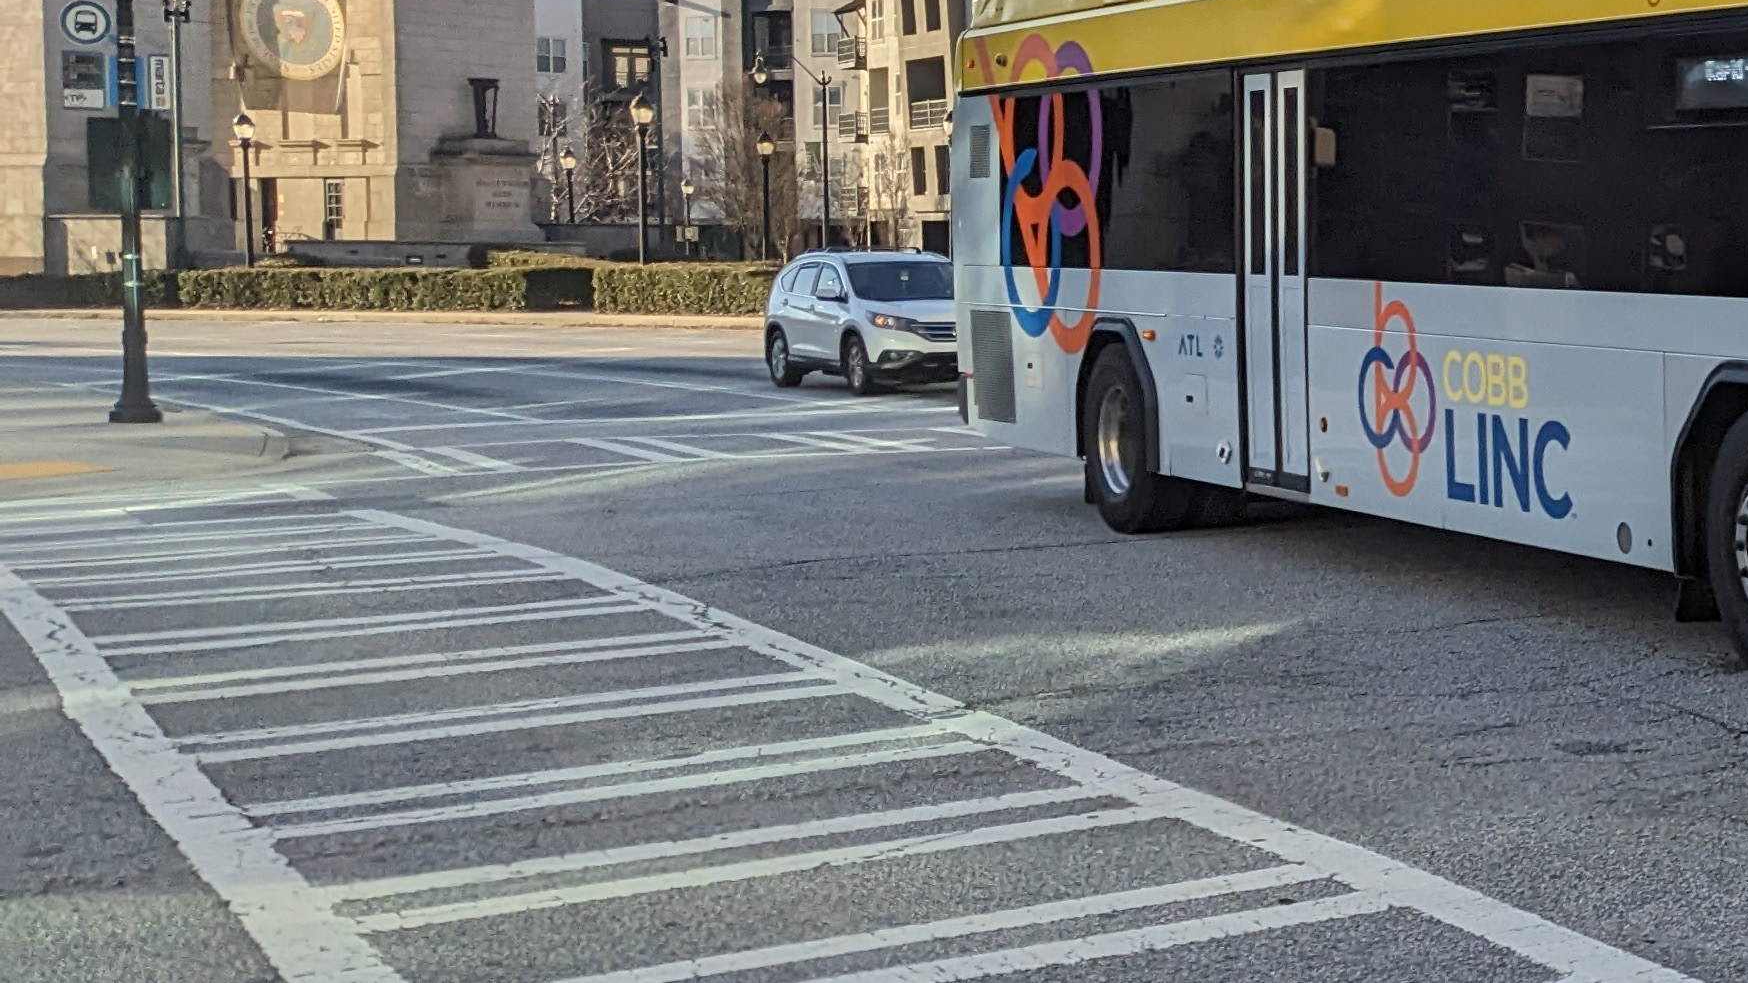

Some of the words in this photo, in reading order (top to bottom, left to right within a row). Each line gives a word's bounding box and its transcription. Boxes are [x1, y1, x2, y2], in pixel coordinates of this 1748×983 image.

[1178, 334, 1203, 357] ATL
[1443, 350, 1529, 409] COBB
[1444, 408, 1574, 520] LINC
